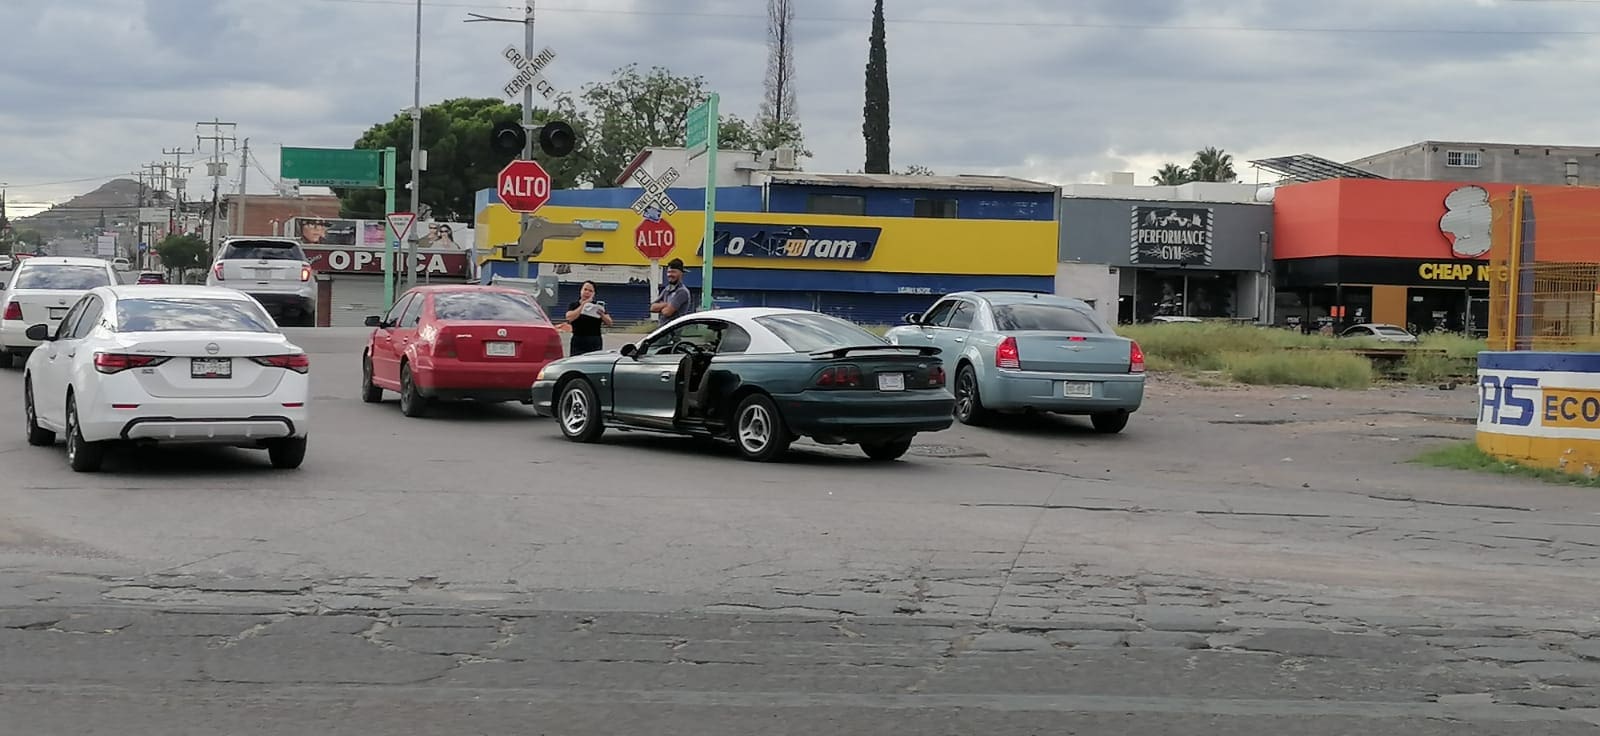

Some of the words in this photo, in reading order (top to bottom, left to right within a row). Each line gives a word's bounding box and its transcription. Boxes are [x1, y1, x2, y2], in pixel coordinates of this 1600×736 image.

[504, 48, 556, 98] FERROCARRIL
[501, 175, 547, 198] ALTO
[634, 168, 677, 213] CUIDADO
[637, 230, 673, 247] ALTO
[1138, 229, 1205, 245] PERFORMANCE
[1162, 245, 1182, 260] GYM
[1418, 263, 1474, 281] CHEAP
